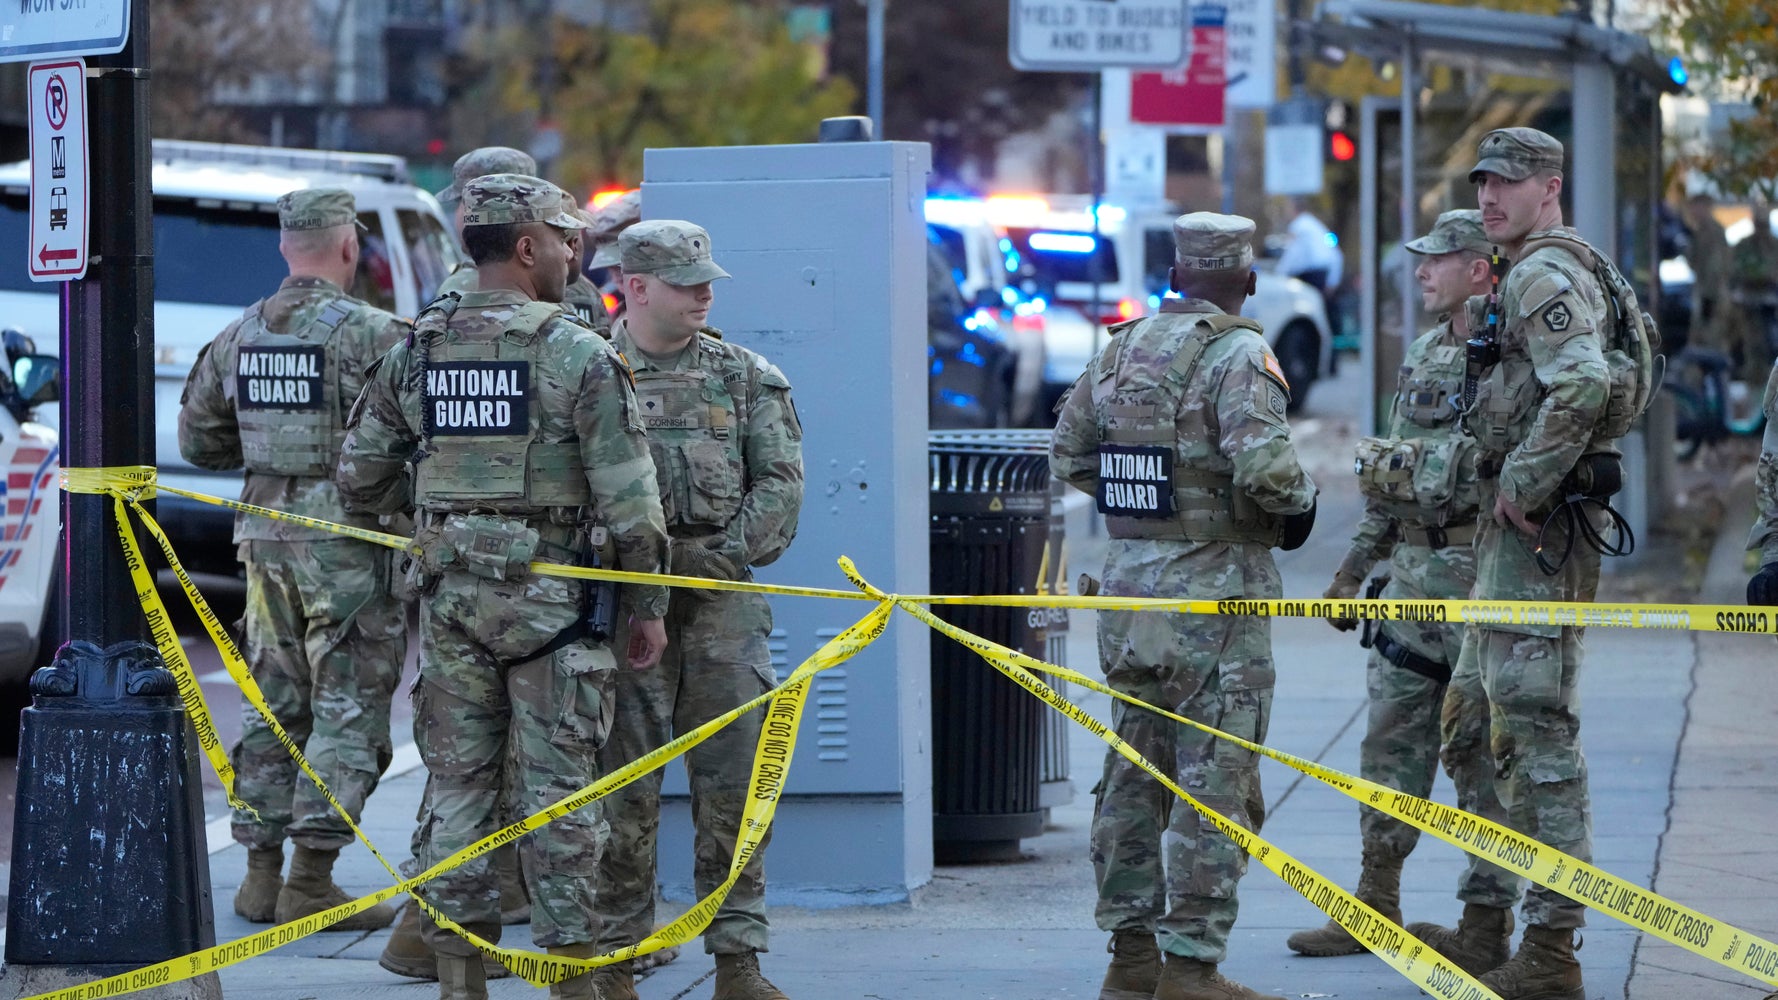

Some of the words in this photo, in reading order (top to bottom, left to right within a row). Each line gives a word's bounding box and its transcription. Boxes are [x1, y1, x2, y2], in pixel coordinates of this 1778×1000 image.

[1023, 5, 1074, 26] YIELD
[1086, 6, 1109, 26] TO
[1117, 7, 1178, 28] BUSES
[1051, 31, 1088, 50] AND
[1097, 32, 1150, 52] BIKES
[1198, 257, 1225, 269] SMITH
[238, 352, 320, 378] NATIONAL
[248, 379, 310, 404] GUARD
[426, 369, 523, 397] NATIONAL
[723, 372, 742, 385] RMY
[435, 400, 511, 428] GUARD
[648, 418, 687, 427] CORNISH
[1100, 452, 1168, 481] NATIONAL
[1105, 482, 1158, 510] GUARD
[1217, 601, 1270, 616] CROSS
[1277, 602, 1305, 617] NOT
[1311, 602, 1333, 618] DO
[1338, 603, 1389, 621] SCENE
[1395, 604, 1446, 623] CRIME
[1715, 611, 1768, 633] CROSS
[161, 645, 184, 674] LINE
[175, 670, 192, 691] DO
[182, 686, 203, 714] NOT
[771, 697, 799, 722] LINE
[192, 711, 220, 752] CROSS
[767, 721, 793, 738] DO
[762, 739, 788, 763] NOT
[754, 763, 785, 802] CROSS
[1391, 793, 1433, 825] POLICE
[1429, 805, 1459, 836] LINE
[1455, 816, 1476, 843] DO
[1472, 823, 1502, 854] NOT
[1499, 834, 1539, 871] CROSS
[1281, 862, 1315, 902] CROSS
[1311, 882, 1336, 914] NOT
[1330, 895, 1351, 923] DO
[1567, 867, 1613, 905] POLICE
[1606, 884, 1639, 916] LINE
[1632, 896, 1654, 923] DO
[1649, 903, 1679, 933] NOT
[1673, 912, 1714, 949] CROSS
[1345, 904, 1372, 938] LINE
[1366, 919, 1405, 960] POLICE
[516, 956, 538, 982] NOT
[540, 960, 557, 984] DO
[1425, 961, 1464, 999] CROSS
